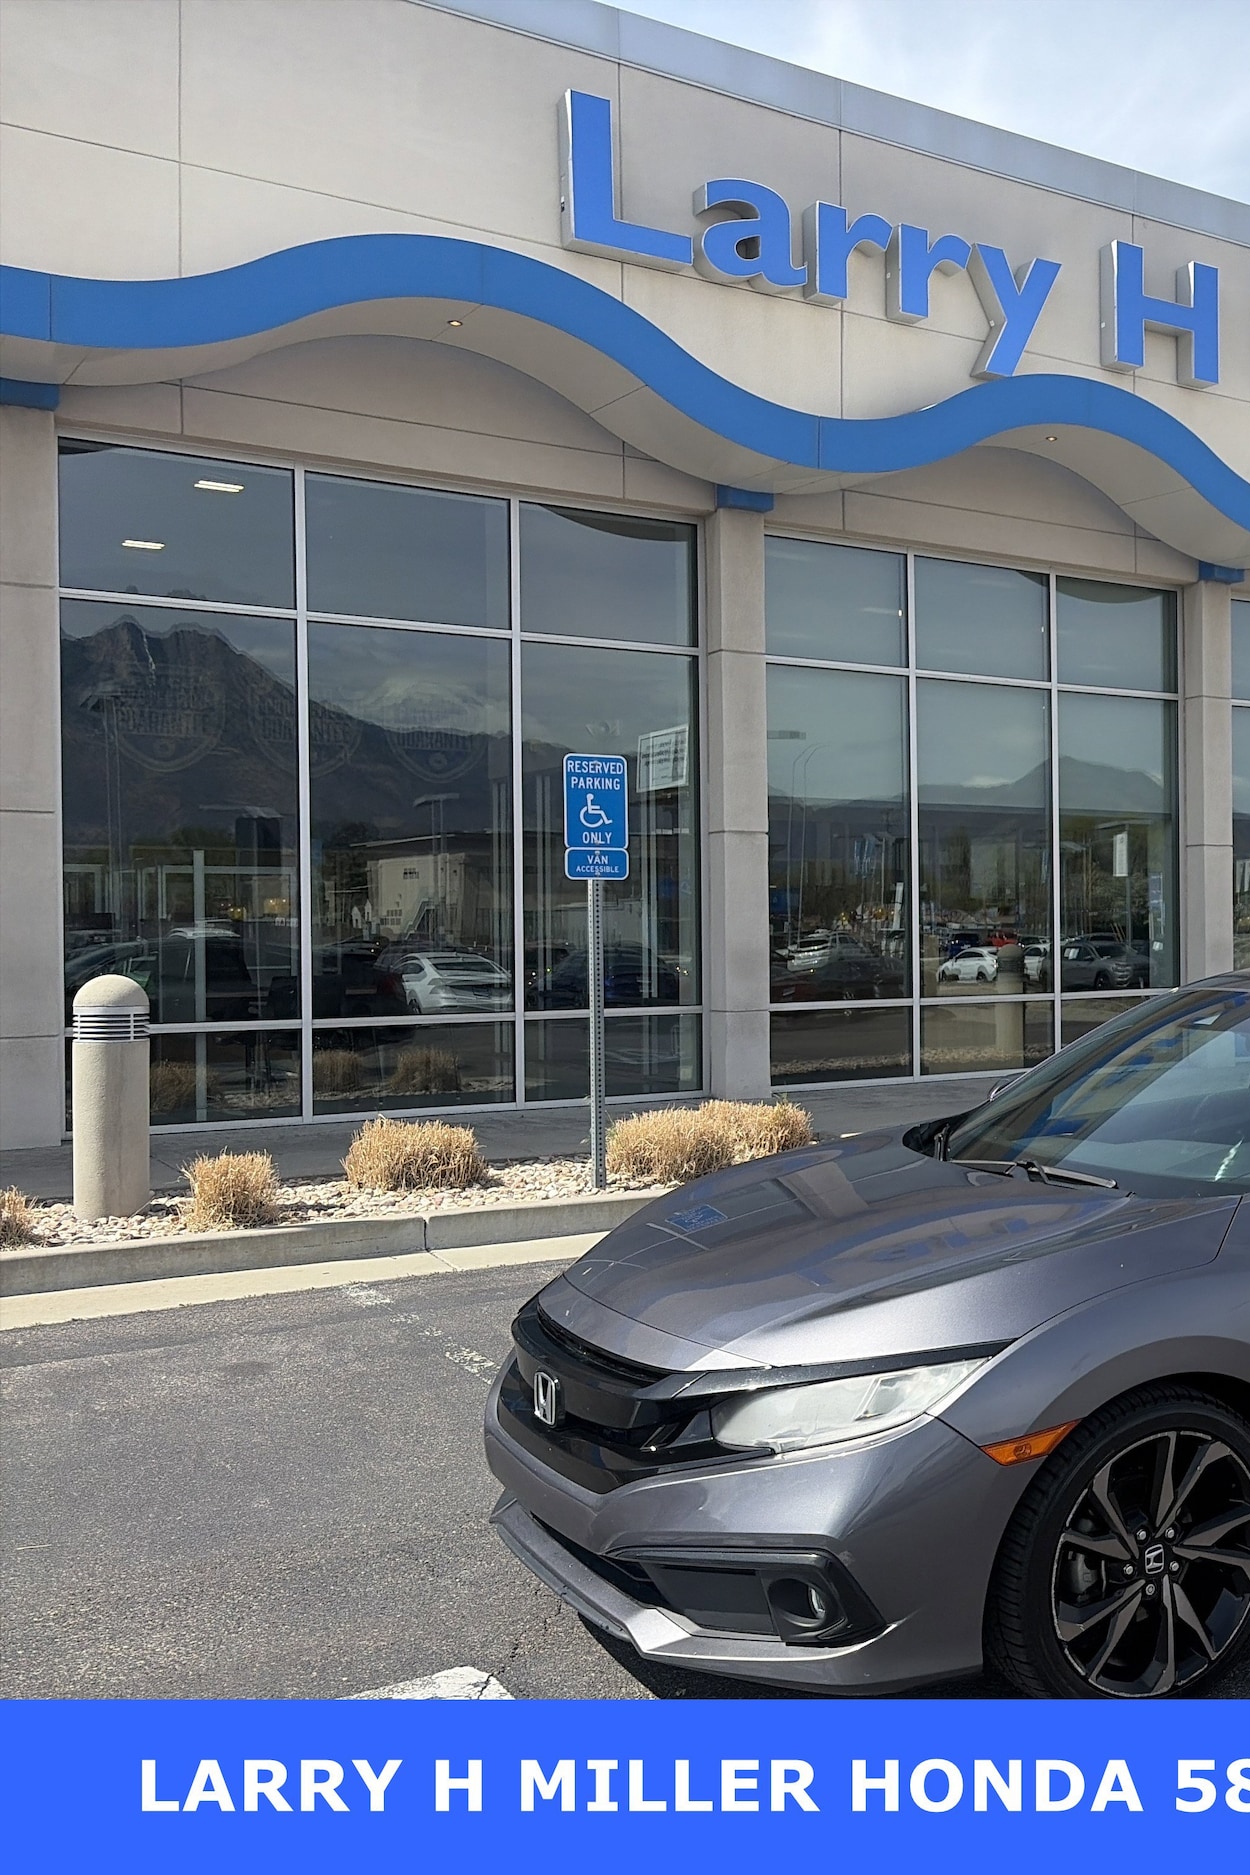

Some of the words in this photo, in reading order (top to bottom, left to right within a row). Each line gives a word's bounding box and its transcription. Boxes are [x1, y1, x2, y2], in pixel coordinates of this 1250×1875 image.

[560, 89, 1061, 378] Larry
[1102, 240, 1218, 387] H
[567, 760, 624, 775] RESERVED
[571, 776, 621, 791] PARKING
[582, 831, 612, 845] ONLY
[587, 855, 609, 865] VAN
[575, 865, 620, 873] ACCESSIBLE
